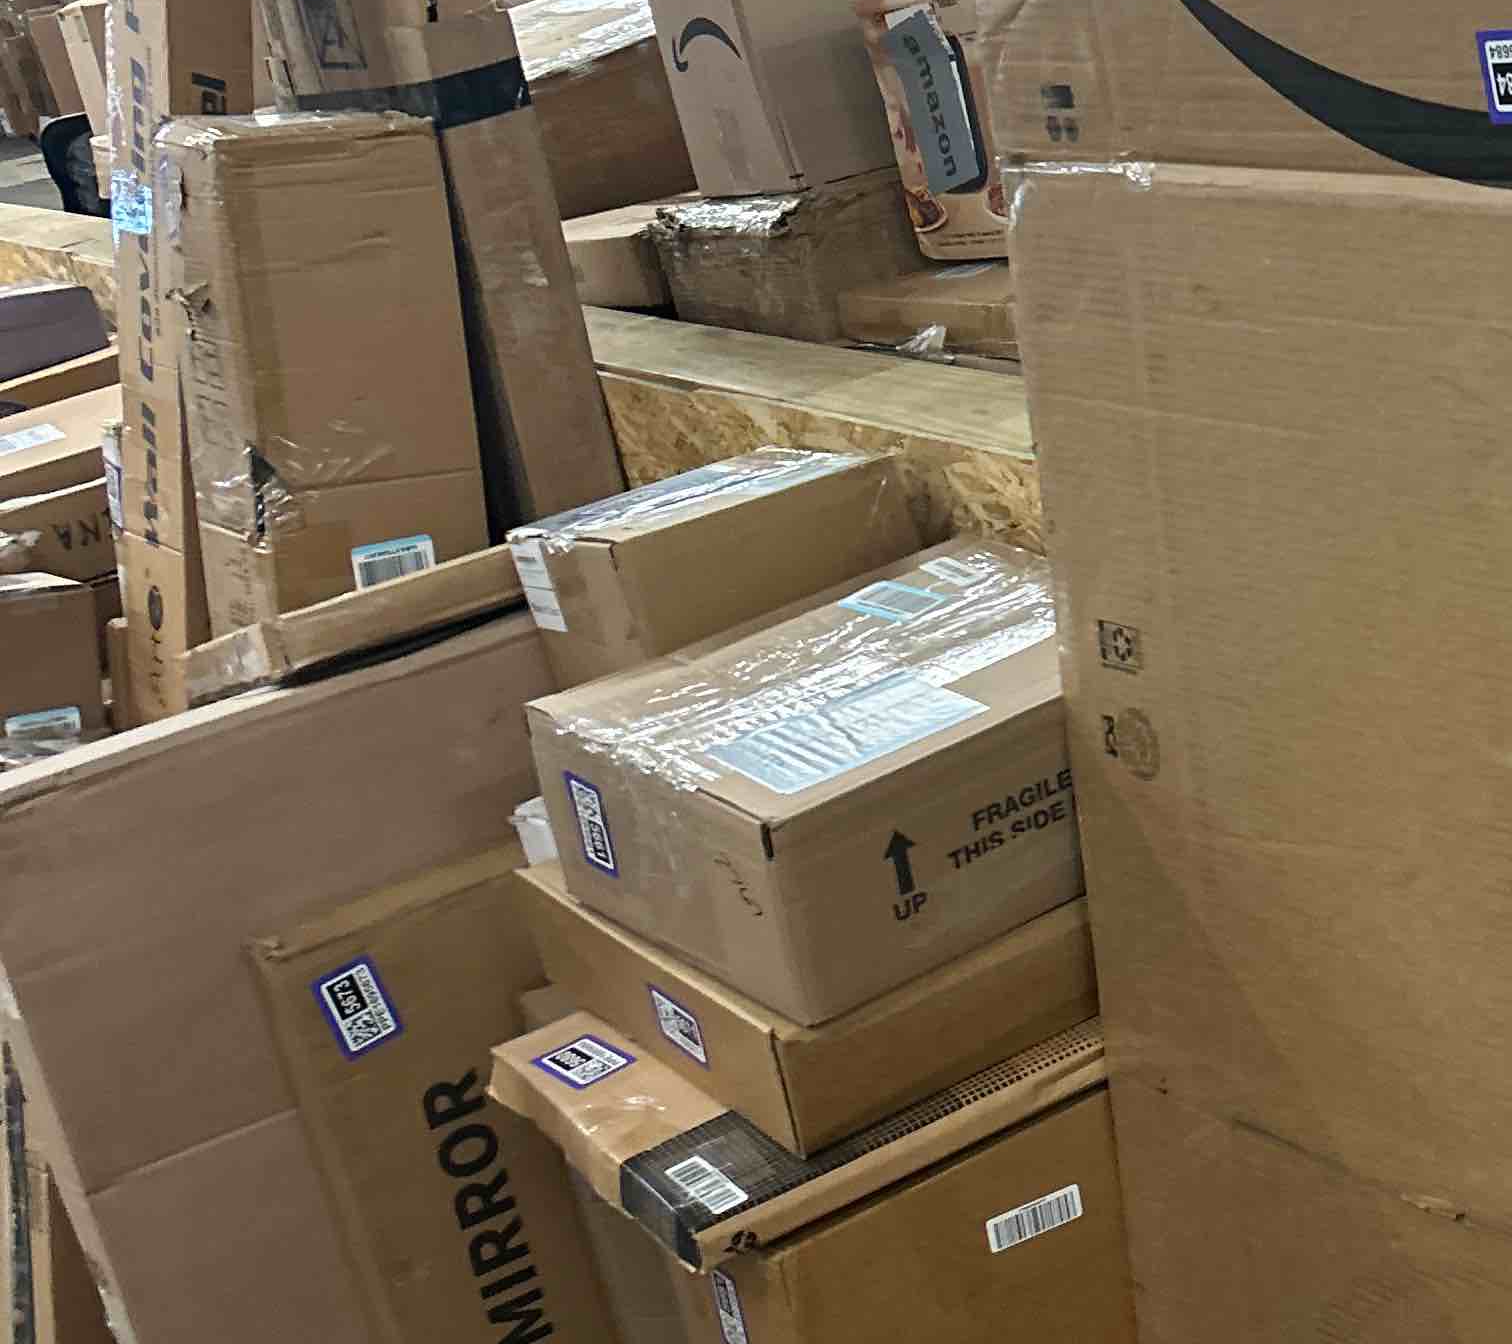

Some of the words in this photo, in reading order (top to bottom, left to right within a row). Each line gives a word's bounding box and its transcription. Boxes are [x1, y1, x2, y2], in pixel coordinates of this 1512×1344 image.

[903, 34, 958, 178] amazon
[972, 768, 1073, 831] FRAGILE
[947, 831, 1005, 869] THIS
[1010, 800, 1067, 838] SIDE
[893, 892, 927, 921] UP
[333, 979, 361, 1015] 5673
